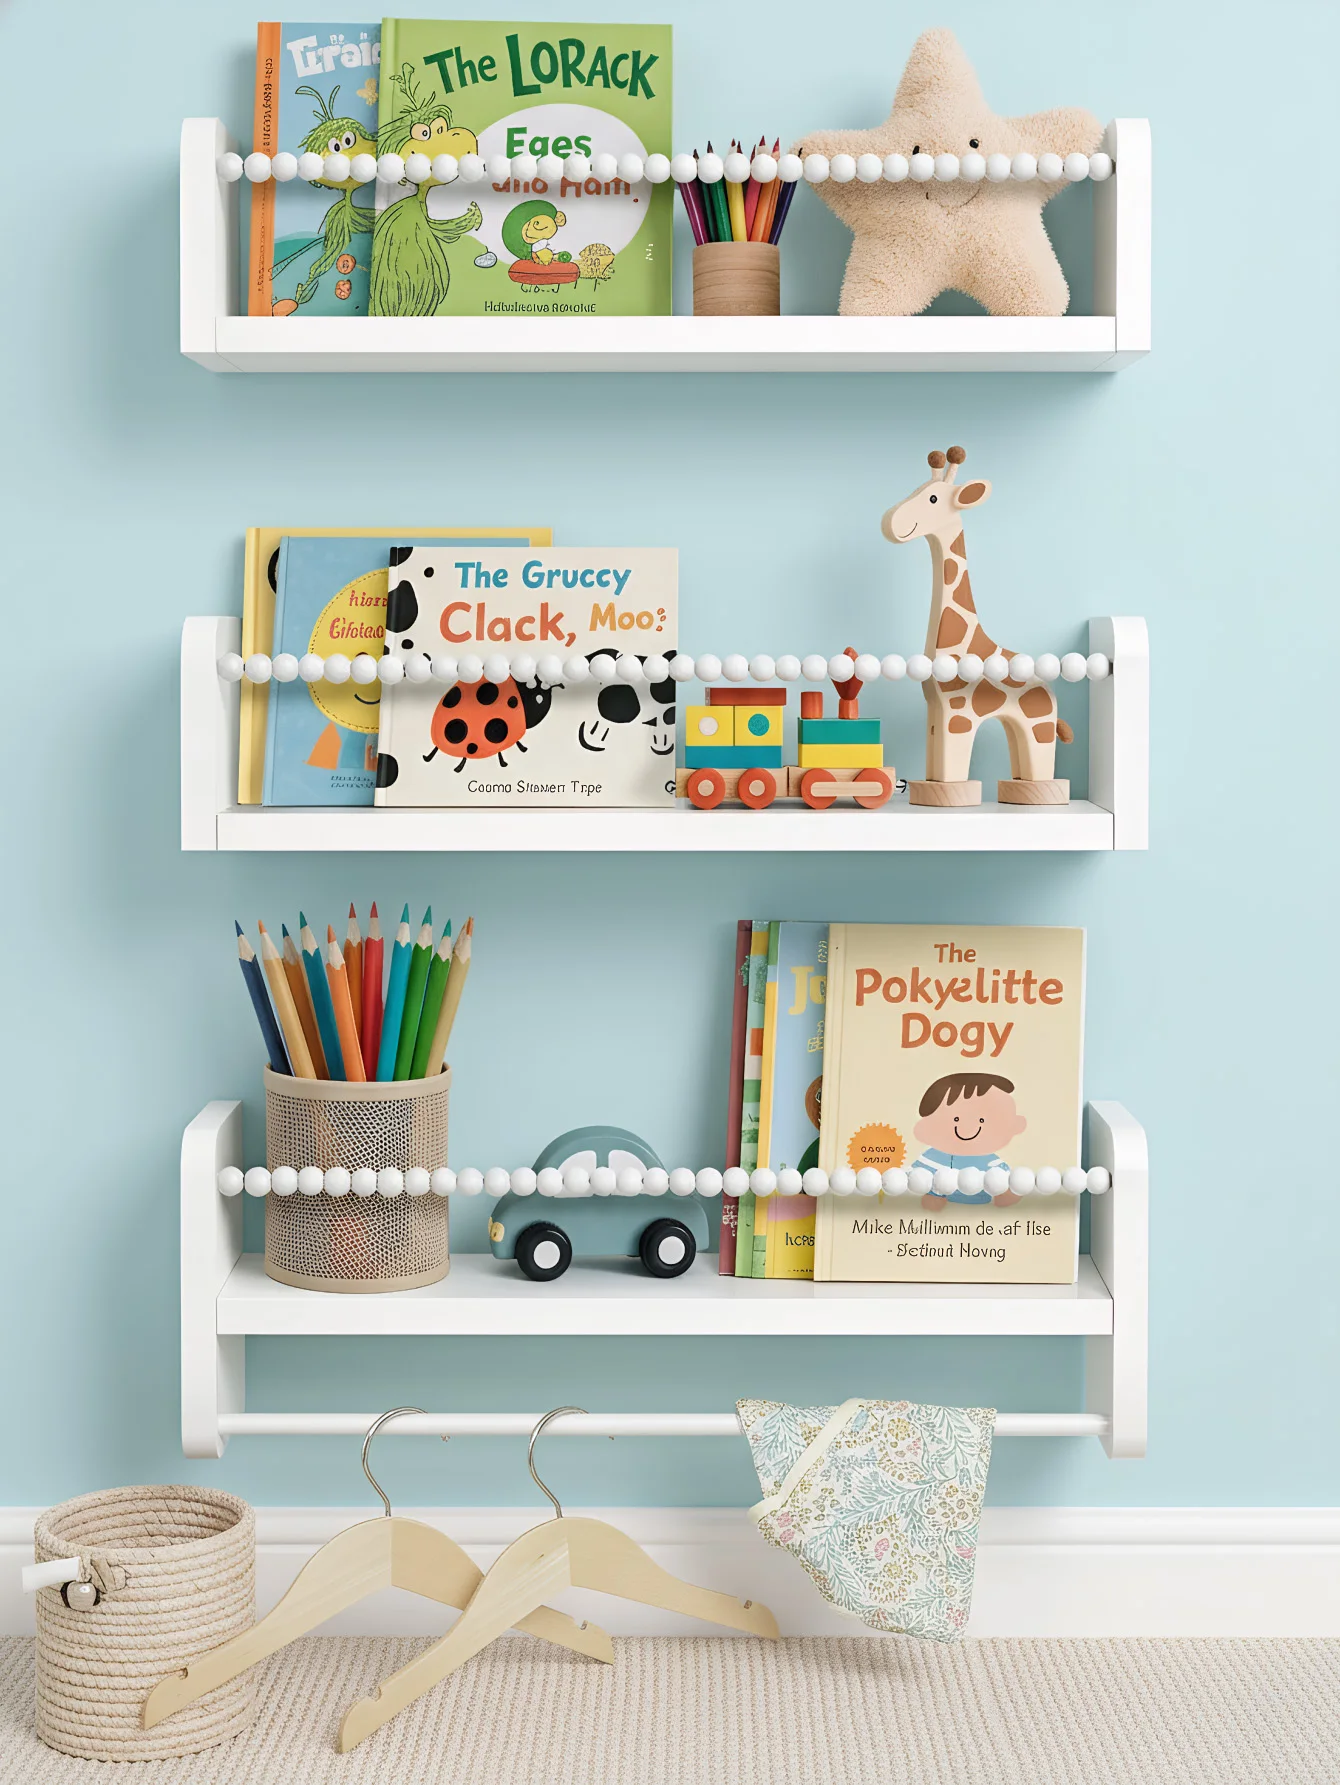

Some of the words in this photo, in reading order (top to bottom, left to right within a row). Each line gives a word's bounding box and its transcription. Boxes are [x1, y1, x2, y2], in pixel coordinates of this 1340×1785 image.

[423, 46, 498, 95] The
[505, 33, 660, 100] LORACK
[454, 561, 508, 589] The
[522, 559, 632, 596] Gruccy
[439, 601, 577, 648] Clack,
[933, 942, 977, 963] The
[900, 1012, 1015, 1058] Dogy
[851, 1218, 893, 1235] Mike
